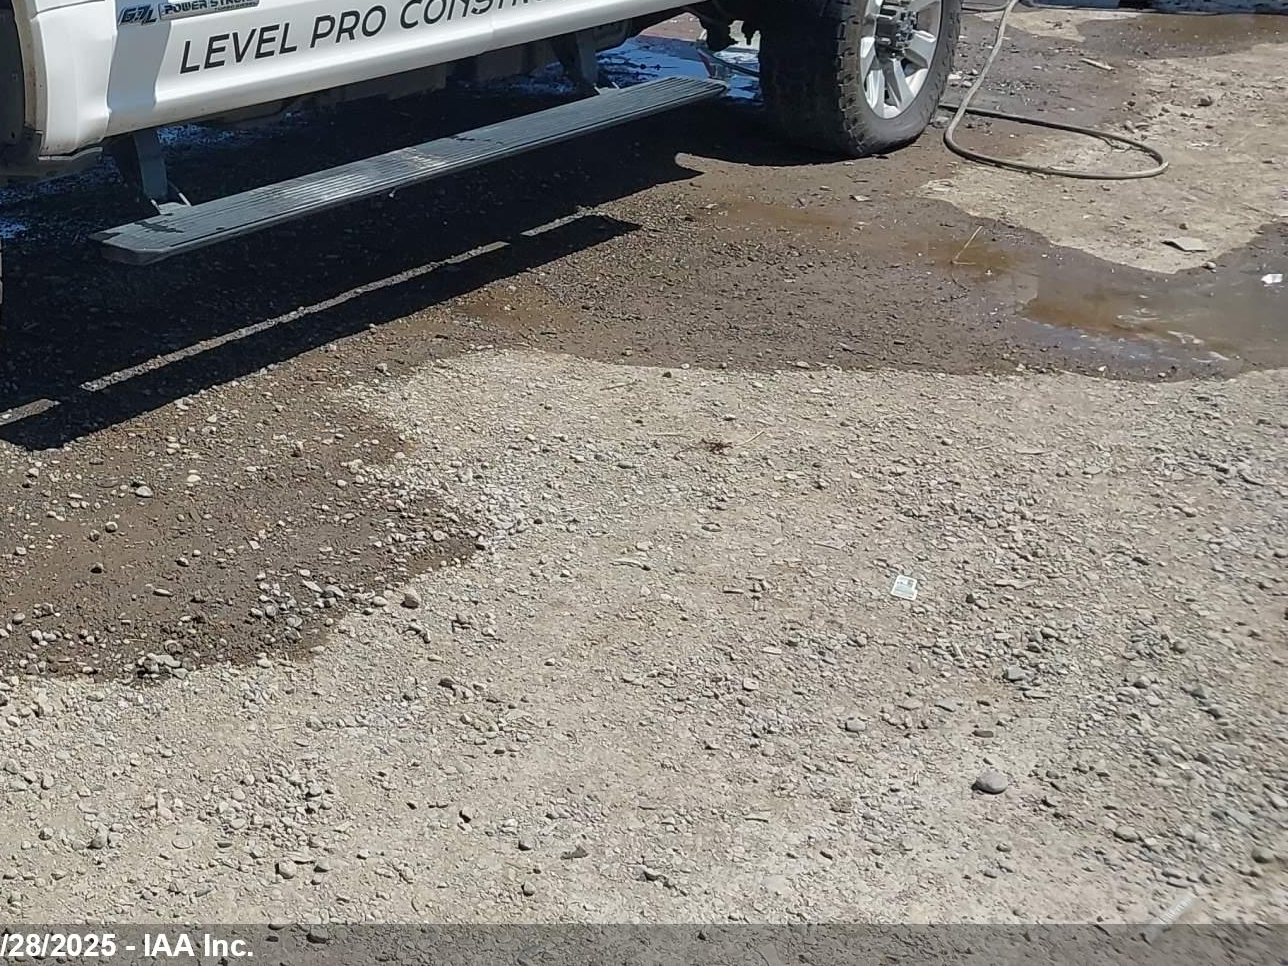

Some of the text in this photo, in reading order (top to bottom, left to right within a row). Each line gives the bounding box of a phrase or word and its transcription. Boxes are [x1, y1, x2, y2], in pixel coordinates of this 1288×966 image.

[164, 0, 208, 15] POWER
[180, 22, 298, 74] LEVEL
[310, 4, 387, 48] PRO
